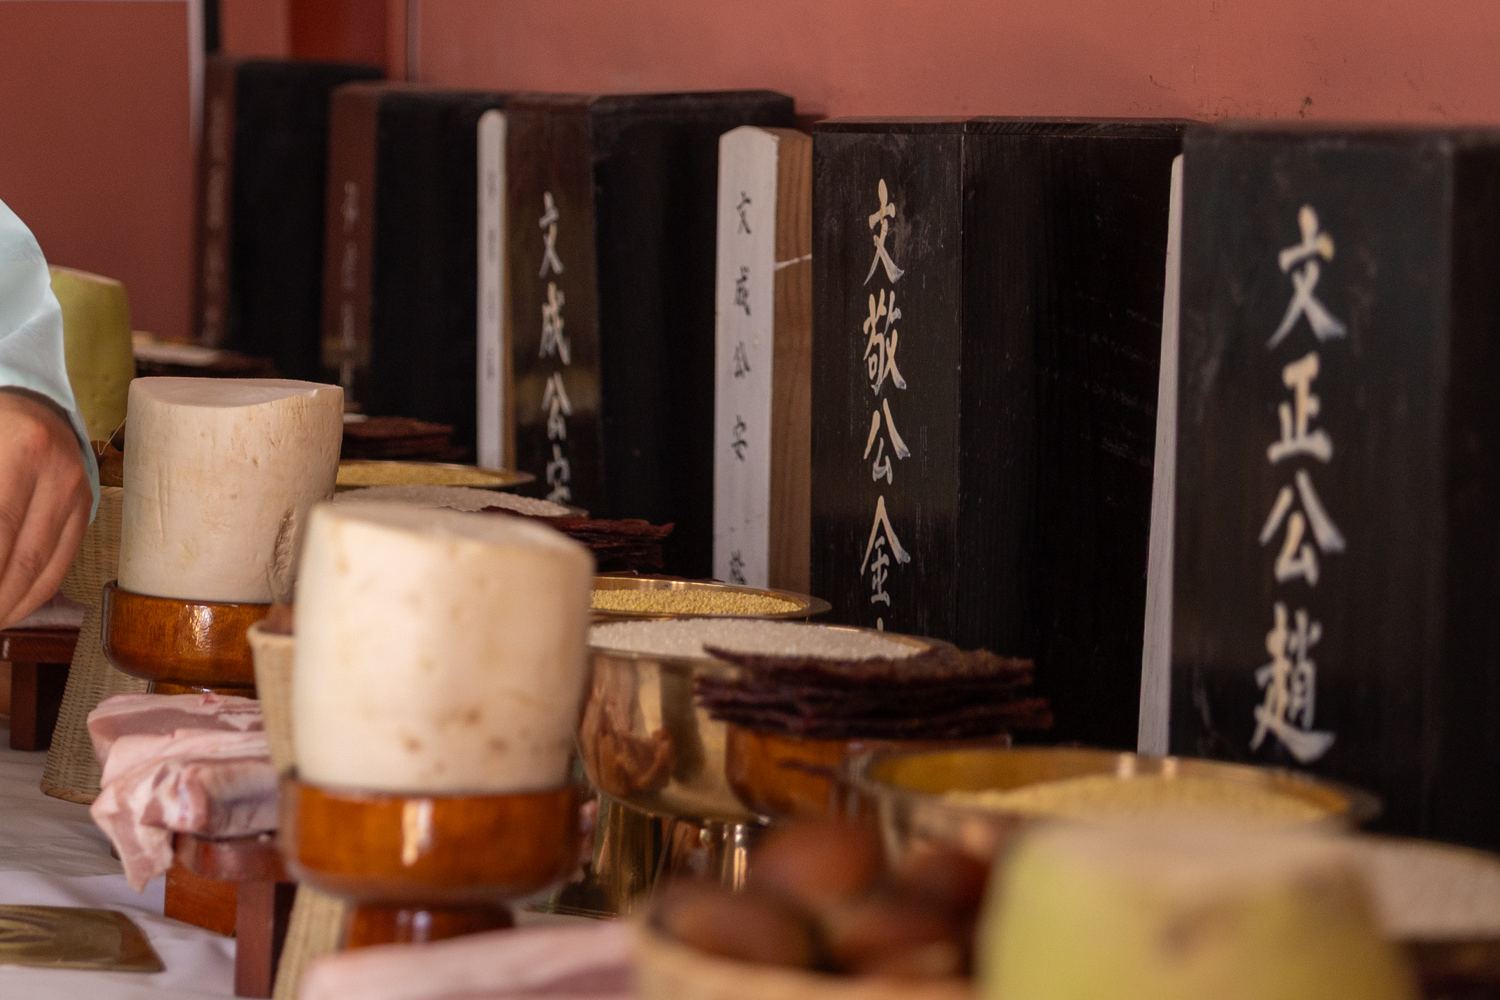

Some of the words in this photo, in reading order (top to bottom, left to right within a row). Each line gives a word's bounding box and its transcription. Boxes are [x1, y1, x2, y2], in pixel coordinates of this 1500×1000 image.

[860, 178, 911, 632] 文敬公金
[1250, 204, 1348, 764] 文正公趙
